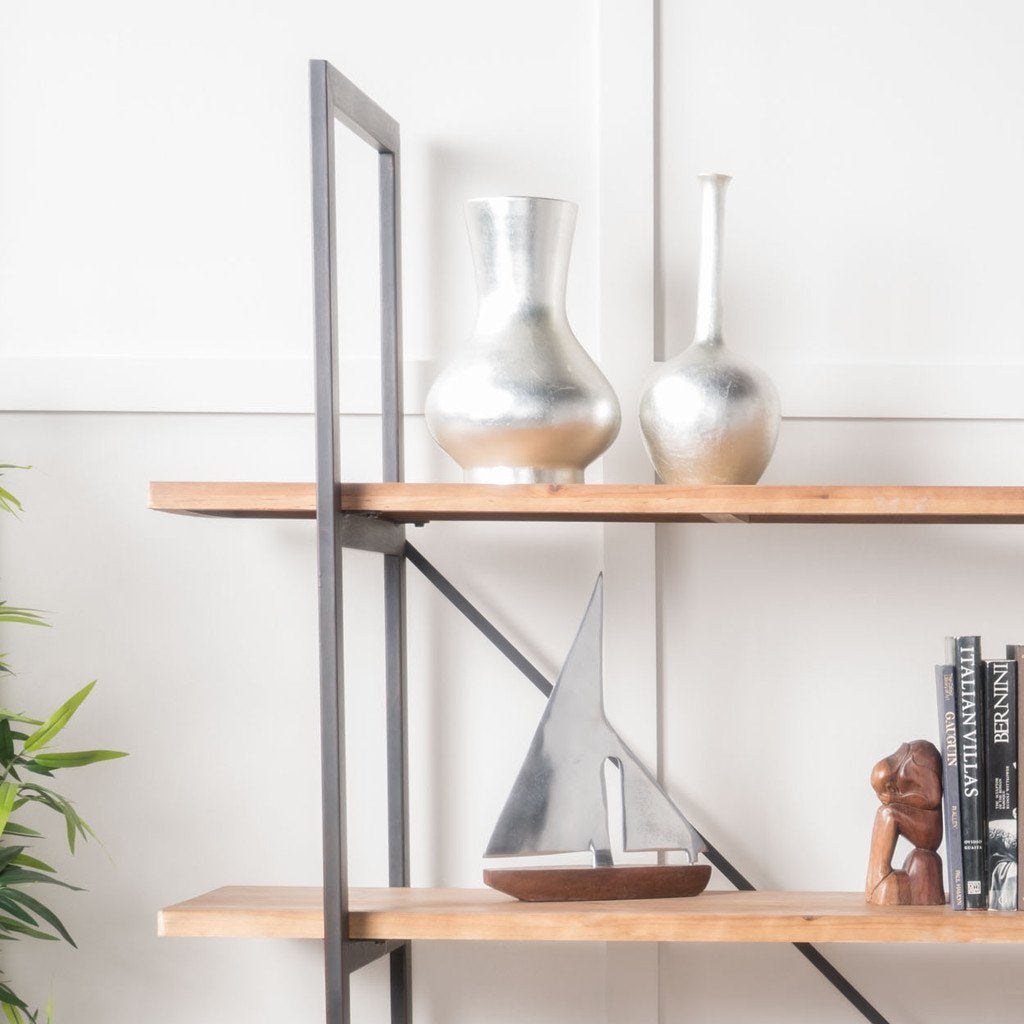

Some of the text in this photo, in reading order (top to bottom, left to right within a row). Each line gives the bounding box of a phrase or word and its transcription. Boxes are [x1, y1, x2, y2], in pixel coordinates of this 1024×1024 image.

[944, 711, 958, 767] GAUGUIN
[960, 647, 979, 798] ITALIAN VILLAS
[993, 661, 1009, 744] BERNINI
